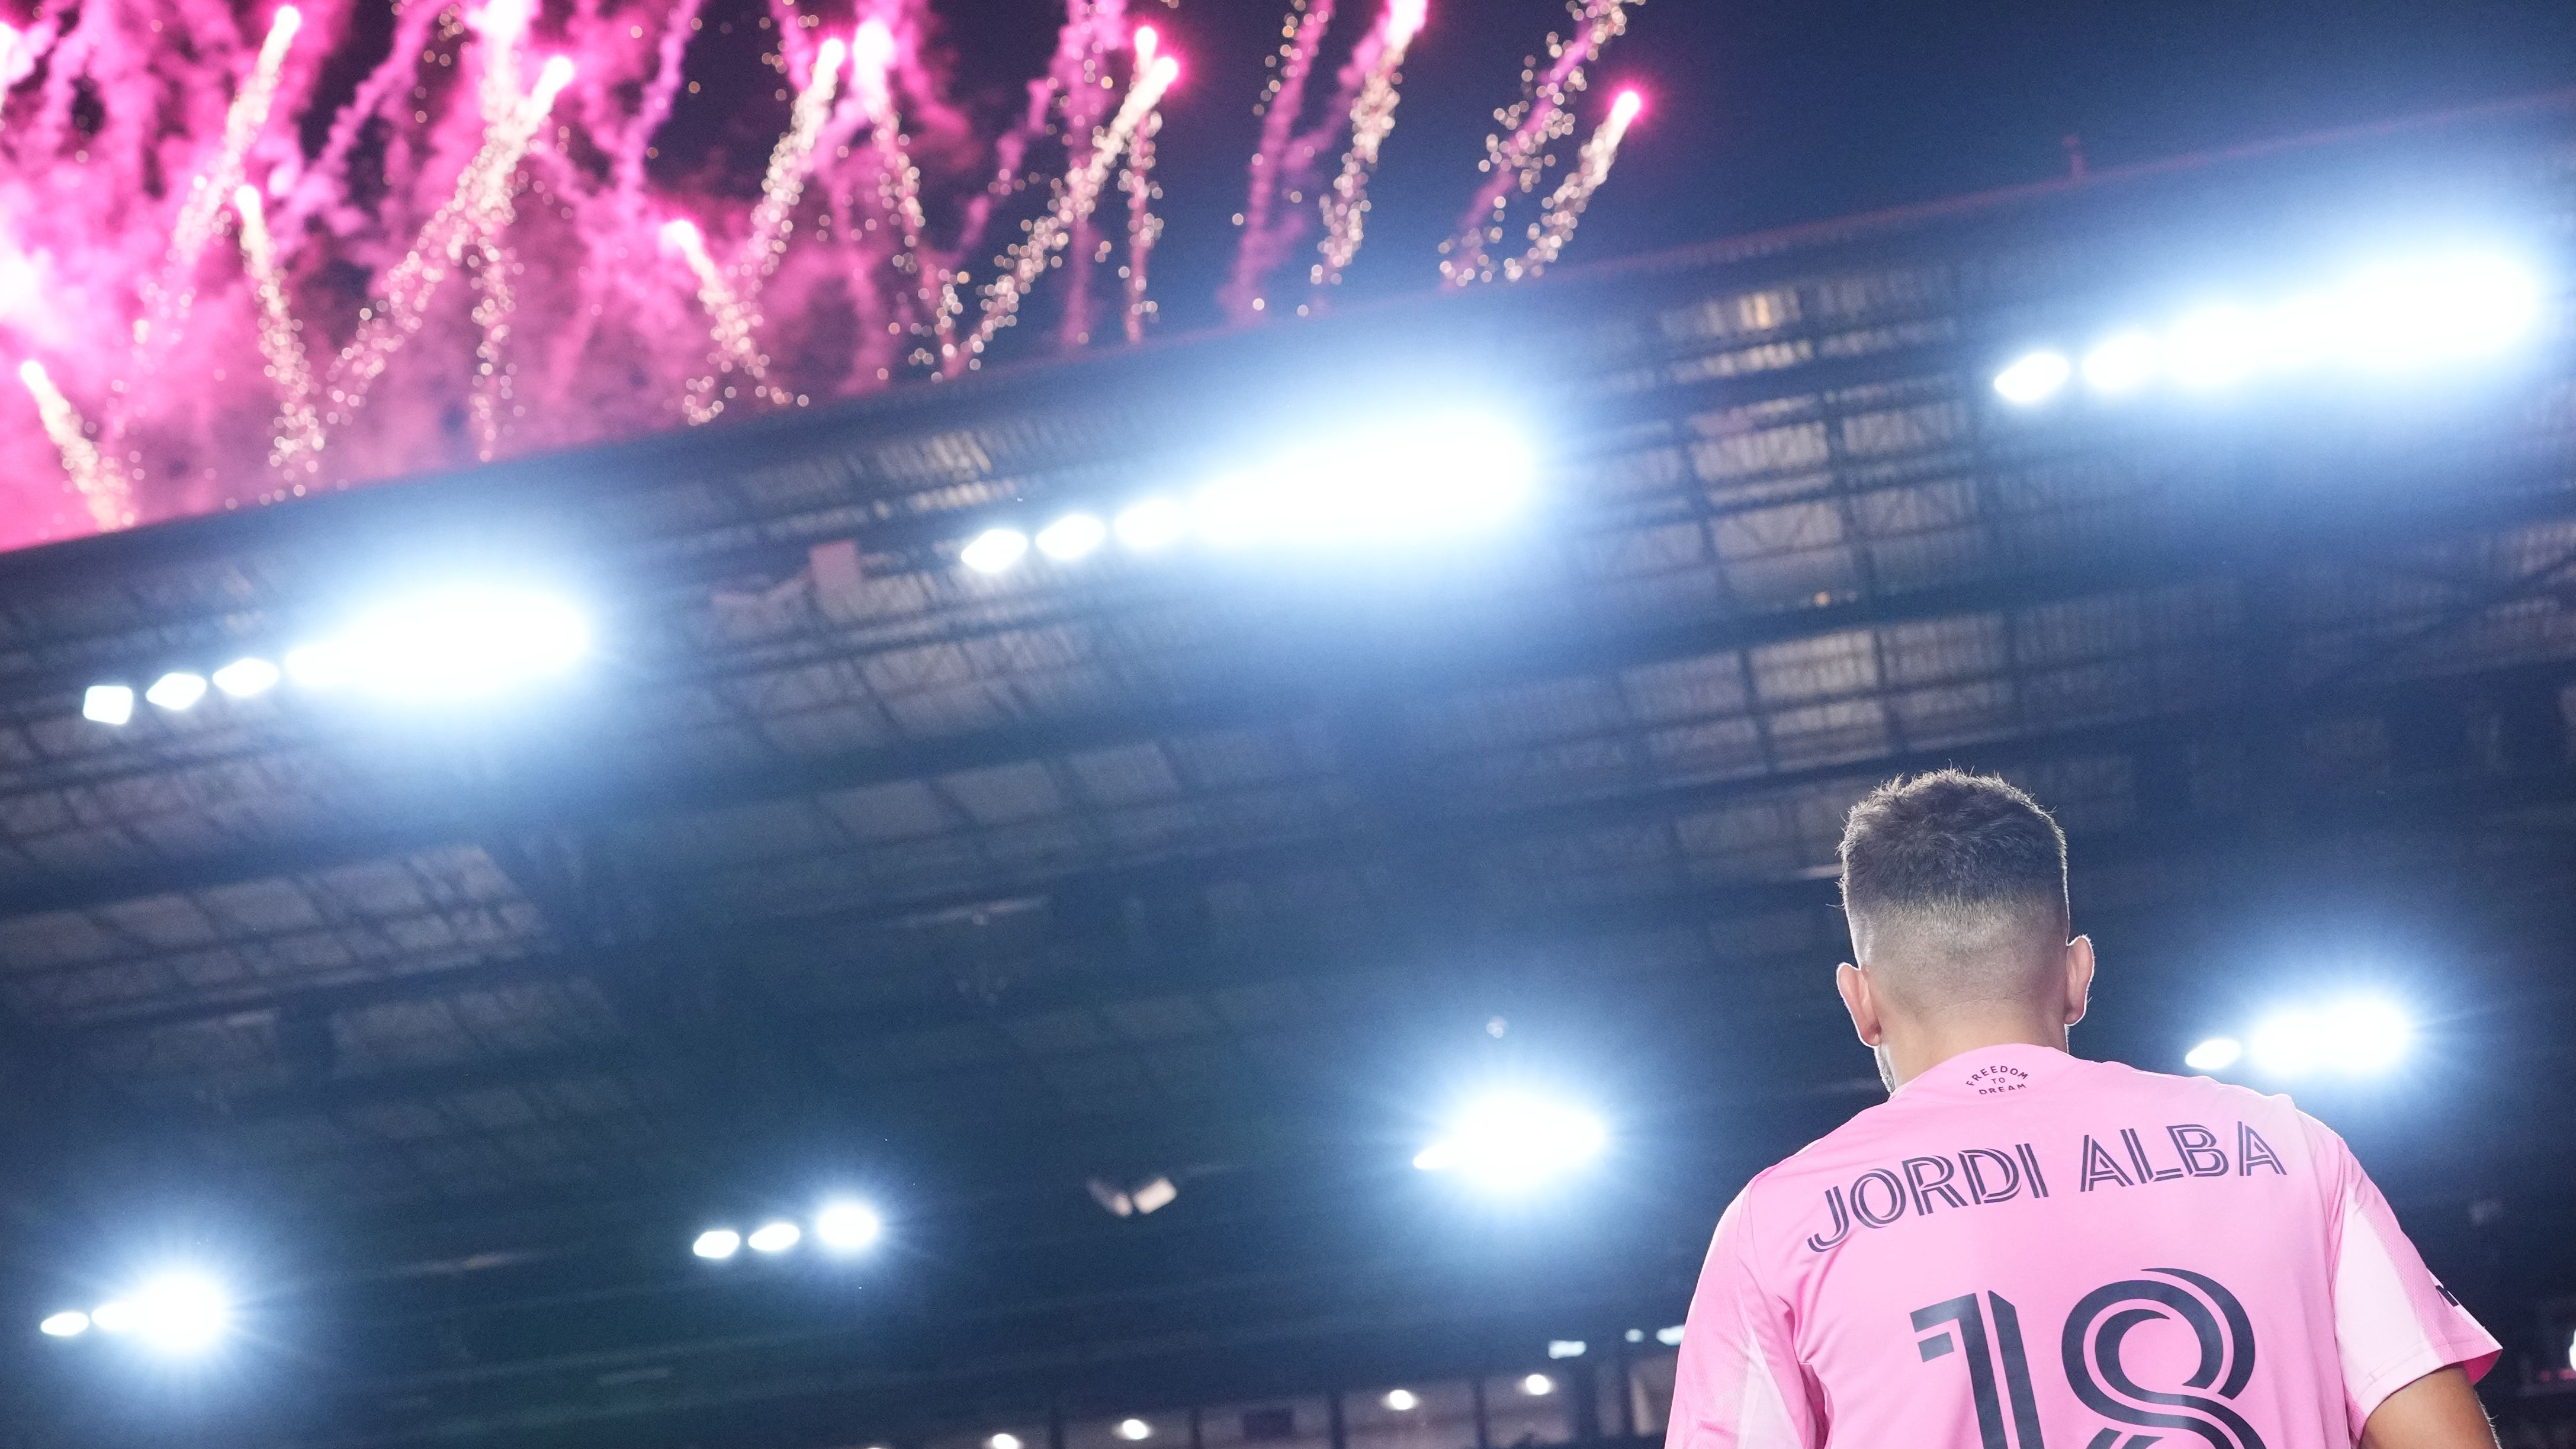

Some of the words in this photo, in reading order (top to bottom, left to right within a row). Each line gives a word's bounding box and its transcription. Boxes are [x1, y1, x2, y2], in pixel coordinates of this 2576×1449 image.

[1965, 1065, 2028, 1086] FREEDOM
[1978, 1084, 2026, 1095] DREAM
[1807, 1143, 2049, 1252] JORDI
[2080, 1121, 2287, 1192] ALBA
[1910, 1267, 2267, 1449] 18
